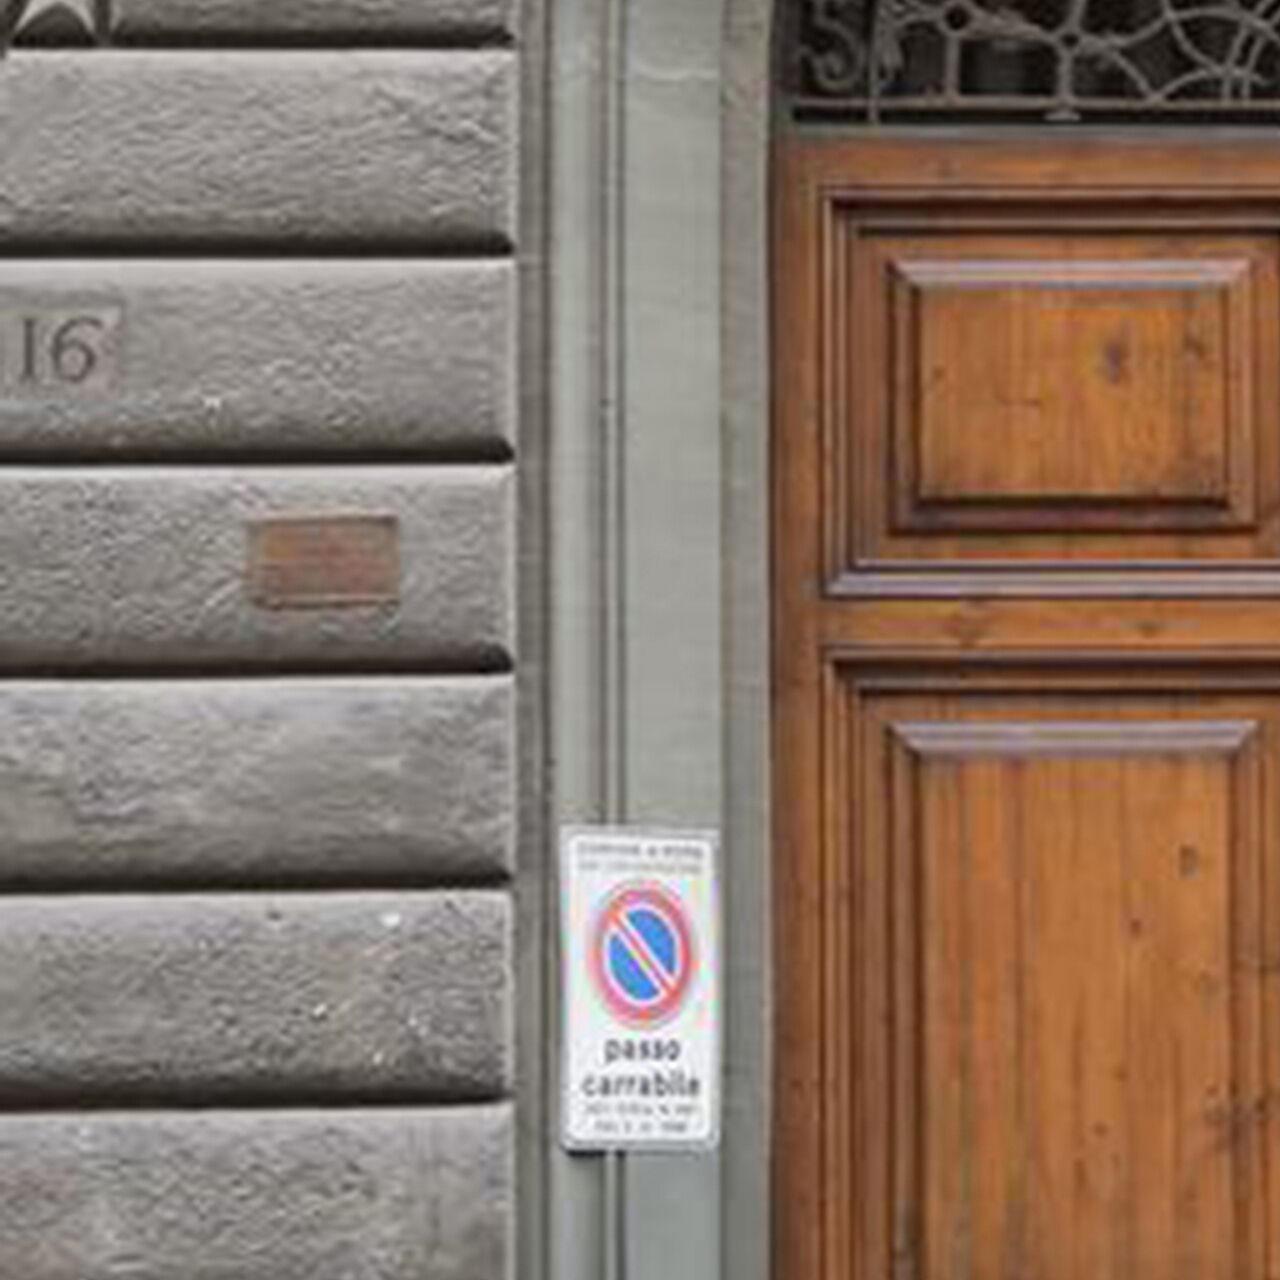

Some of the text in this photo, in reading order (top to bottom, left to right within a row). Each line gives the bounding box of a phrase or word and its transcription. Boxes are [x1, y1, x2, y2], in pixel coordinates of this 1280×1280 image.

[19, 316, 102, 384] 16
[604, 1038, 681, 1065] passo
[581, 1070, 700, 1097] carrabile
